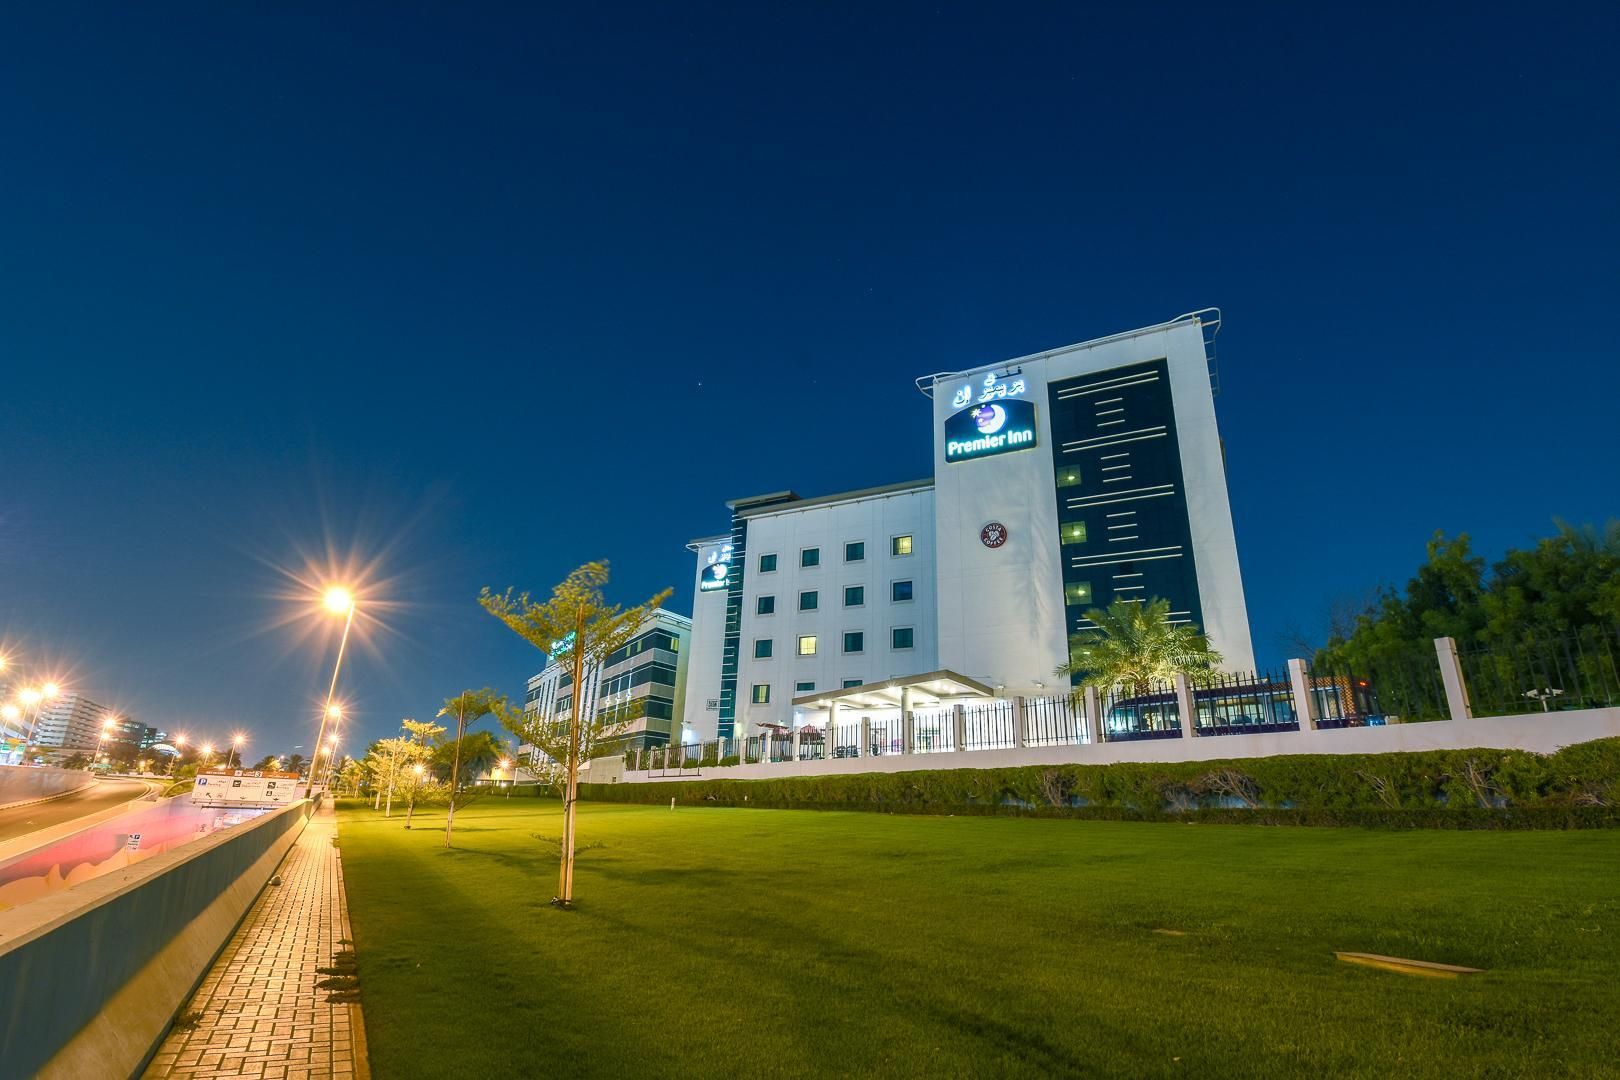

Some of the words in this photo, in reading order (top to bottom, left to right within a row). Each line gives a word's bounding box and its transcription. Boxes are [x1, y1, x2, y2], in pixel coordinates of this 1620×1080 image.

[948, 434, 1006, 456] Premier
[1008, 430, 1032, 444] Inn
[984, 537, 1003, 545] COFFEE
